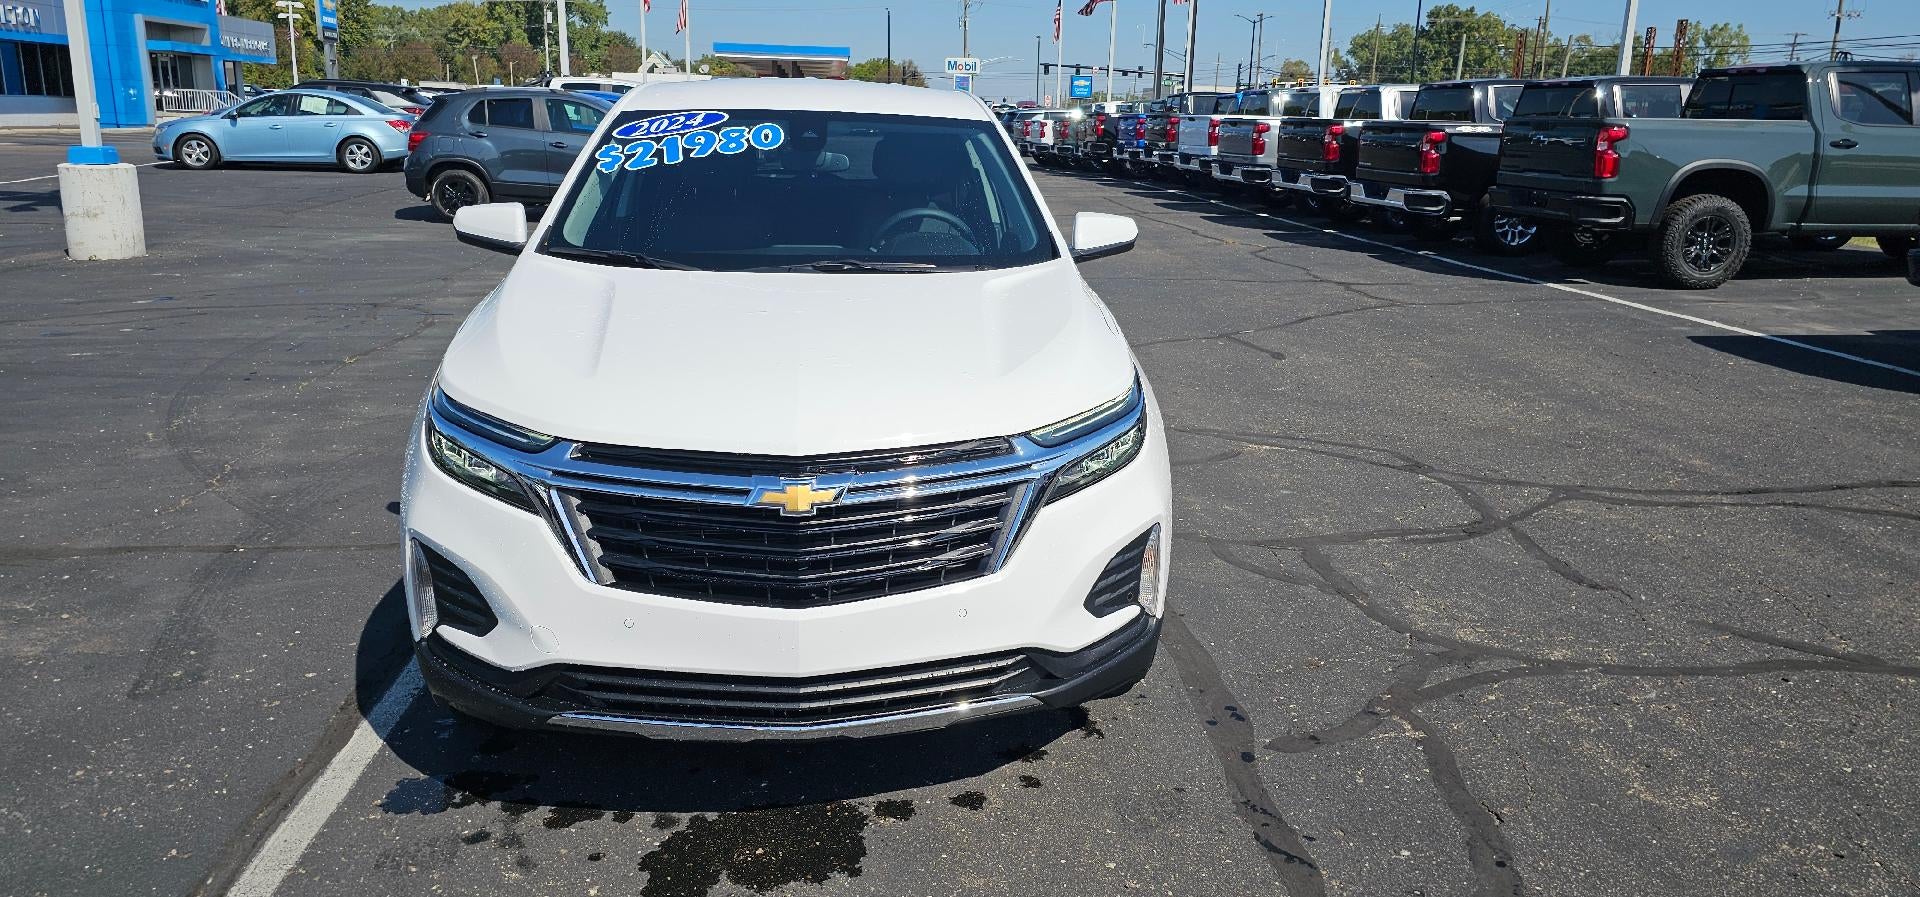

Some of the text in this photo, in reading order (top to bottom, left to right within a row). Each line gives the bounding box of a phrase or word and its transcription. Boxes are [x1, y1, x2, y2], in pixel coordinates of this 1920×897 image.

[947, 60, 977, 71] Mobil
[634, 112, 704, 136] 2024
[595, 122, 785, 173] $21980
